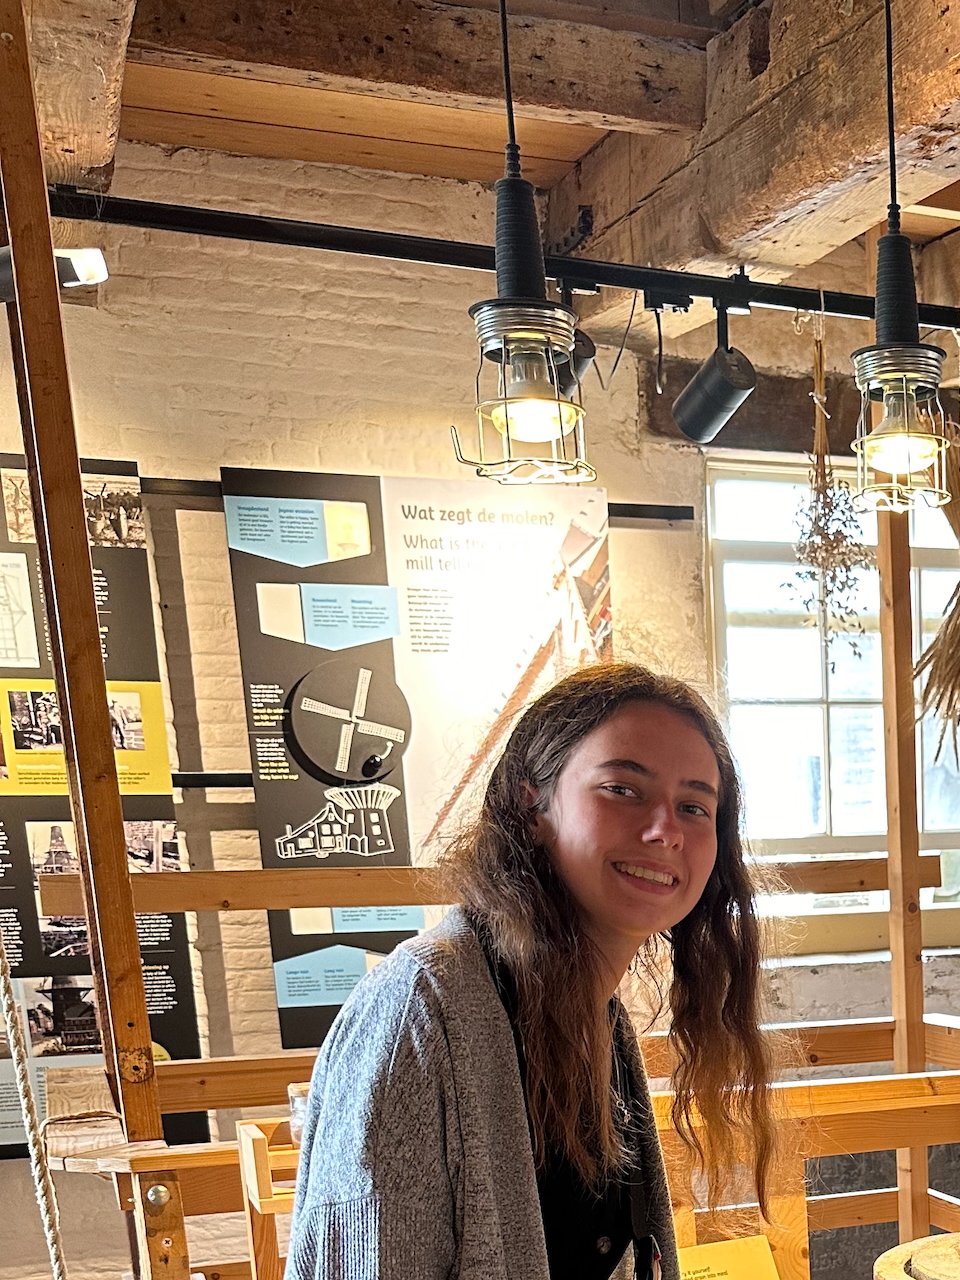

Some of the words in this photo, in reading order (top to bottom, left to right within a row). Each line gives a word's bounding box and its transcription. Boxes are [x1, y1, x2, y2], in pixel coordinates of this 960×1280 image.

[401, 504, 435, 521] Wat
[439, 508, 472, 525] zegt
[477, 507, 496, 523] de
[501, 510, 555, 526] molen?
[403, 534, 445, 550] What
[449, 538, 461, 551] is
[405, 555, 433, 571] mill
